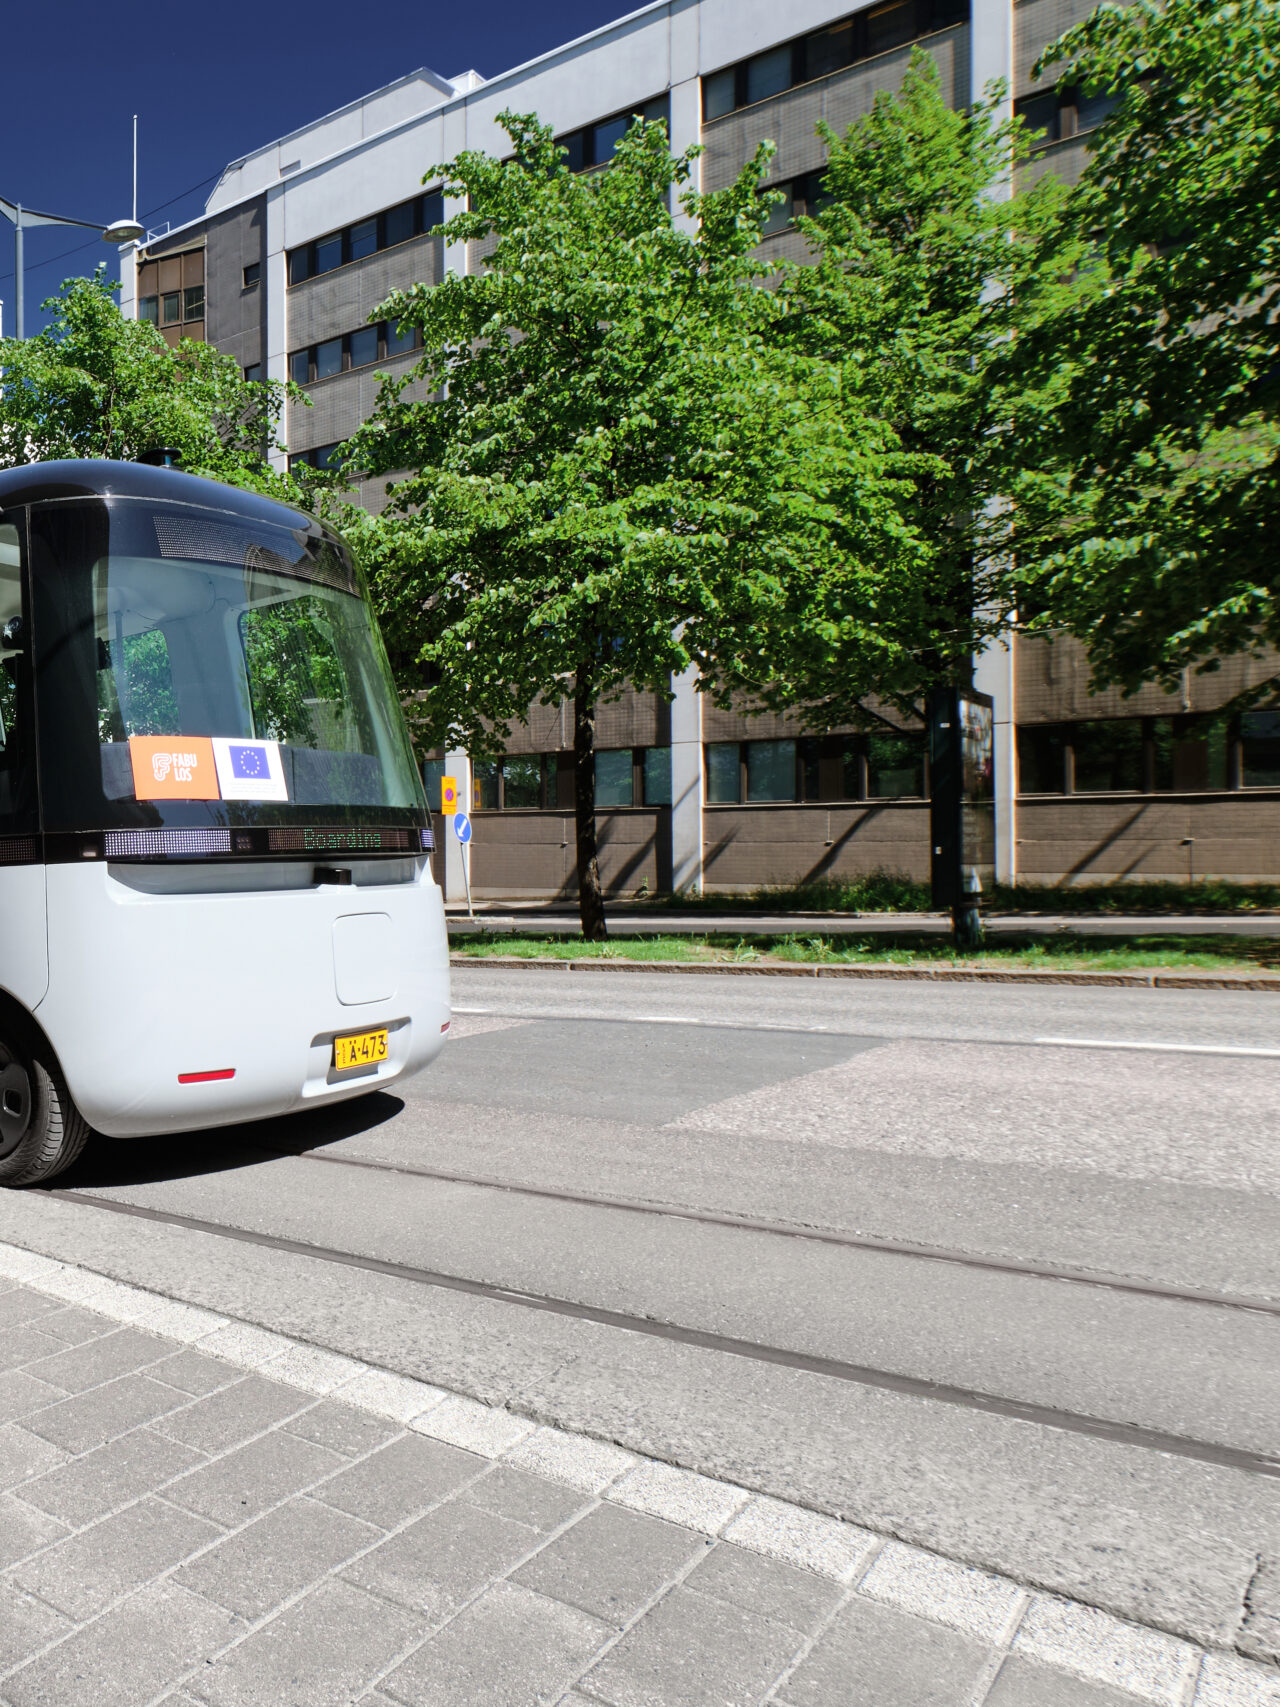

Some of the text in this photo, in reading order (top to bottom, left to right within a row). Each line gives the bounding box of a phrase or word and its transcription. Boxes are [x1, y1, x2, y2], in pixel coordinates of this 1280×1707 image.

[172, 753, 197, 768] FABU
[174, 767, 193, 782] LOS
[304, 828, 381, 849] Boarding
